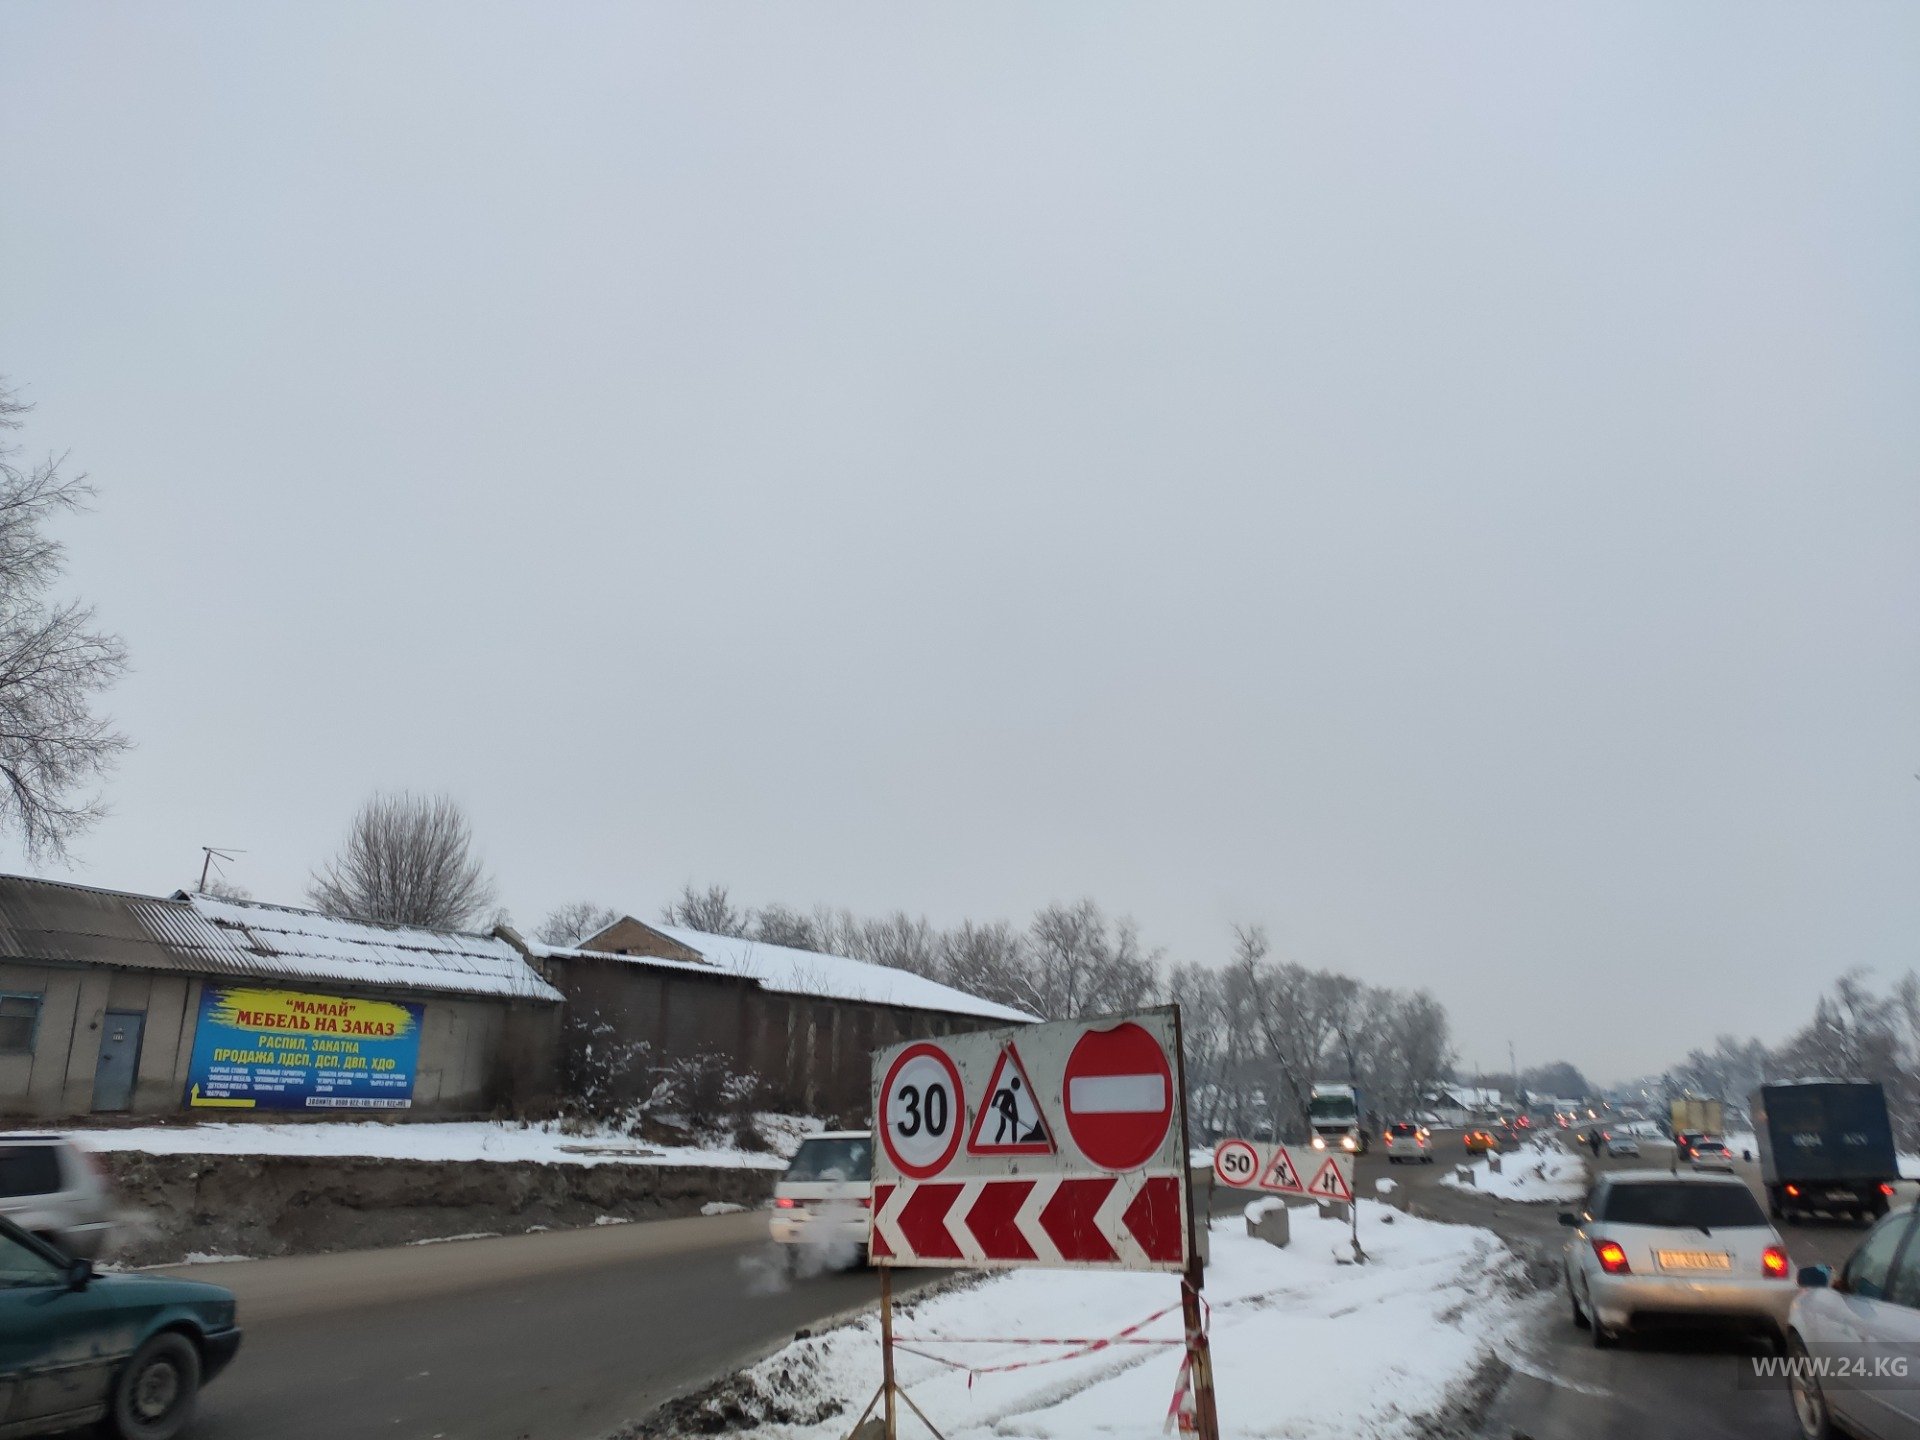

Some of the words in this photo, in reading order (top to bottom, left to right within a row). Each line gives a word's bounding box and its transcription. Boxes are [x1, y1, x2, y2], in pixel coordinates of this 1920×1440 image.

[236, 1010, 311, 1030] МЕБЕЛЬ
[314, 1018, 338, 1032] НА
[341, 1019, 396, 1036] ЗАКАЗ
[311, 1040, 360, 1054] ЗАКАТКА
[213, 1048, 275, 1065] ПРОДАЖА
[371, 1058, 397, 1071] ХДФ
[897, 1084, 948, 1138] 30
[1225, 1153, 1250, 1174] 50
